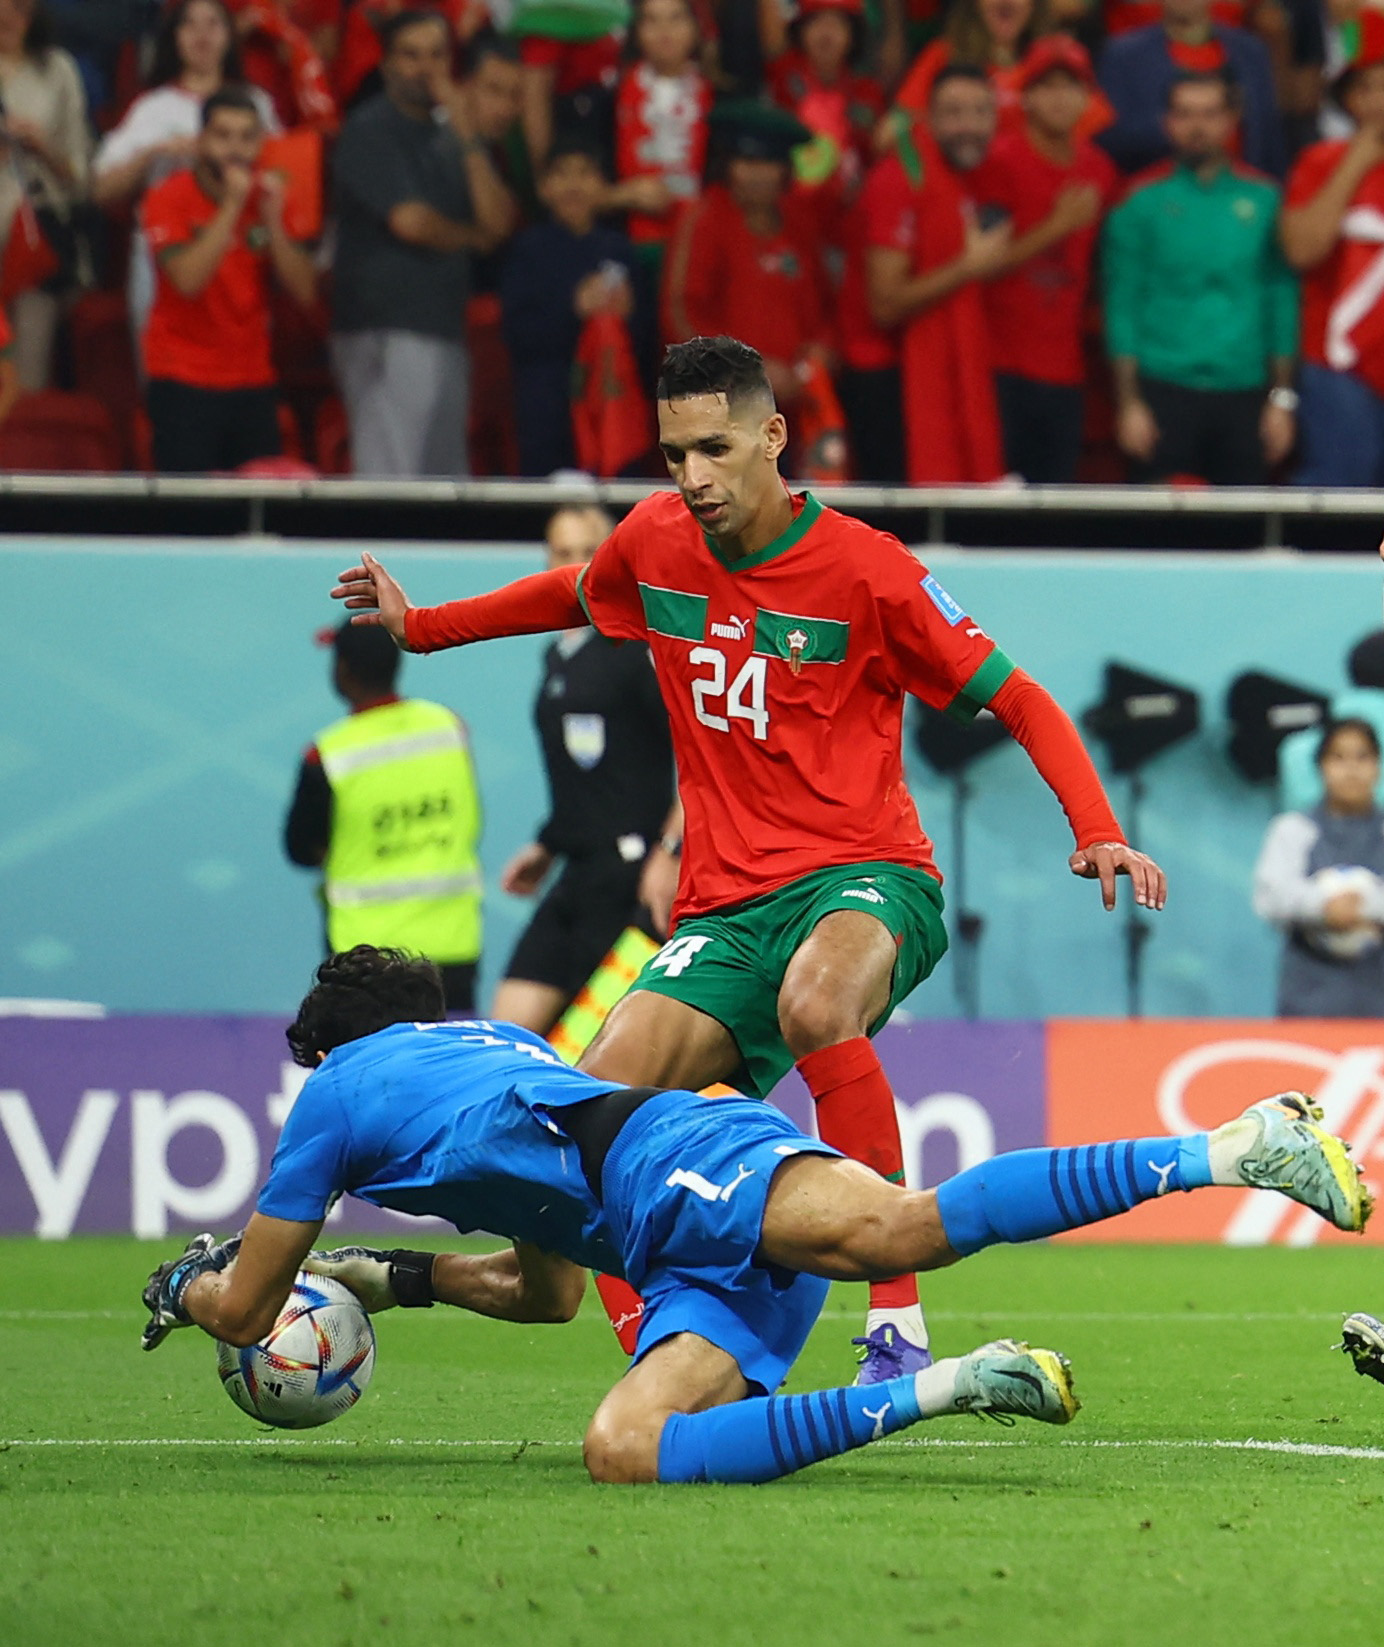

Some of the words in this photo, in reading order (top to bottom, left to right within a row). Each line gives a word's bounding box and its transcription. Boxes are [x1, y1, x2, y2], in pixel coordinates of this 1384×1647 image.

[711, 622, 741, 641] PUMA
[689, 646, 769, 740] 24
[650, 935, 714, 977] 4
